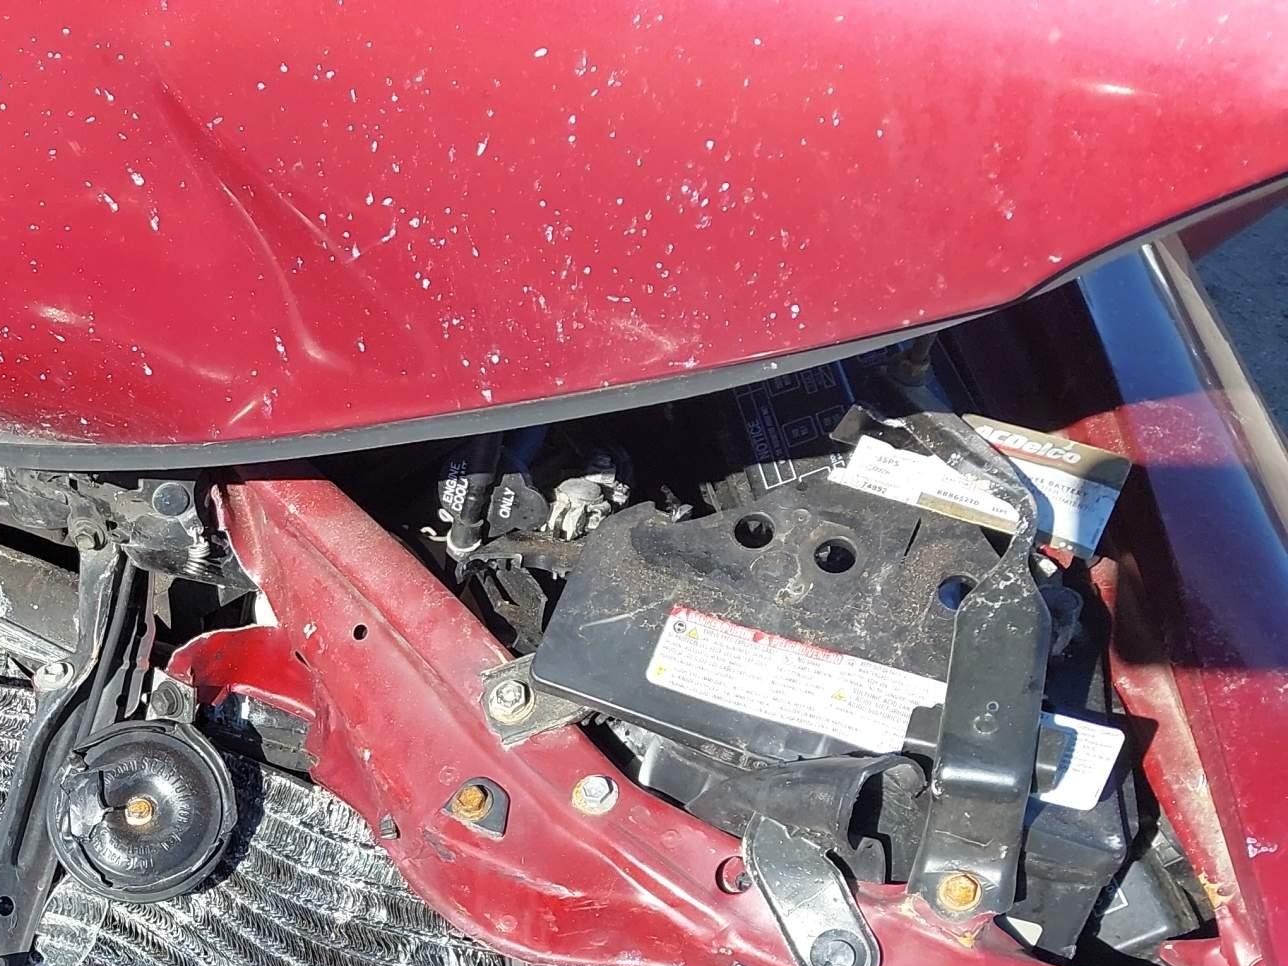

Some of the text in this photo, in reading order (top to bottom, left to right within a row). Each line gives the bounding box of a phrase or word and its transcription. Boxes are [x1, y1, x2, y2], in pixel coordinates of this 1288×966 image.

[976, 425, 1082, 464] ACDelco
[442, 459, 462, 504] ENGINE
[499, 487, 516, 519] ONLY
